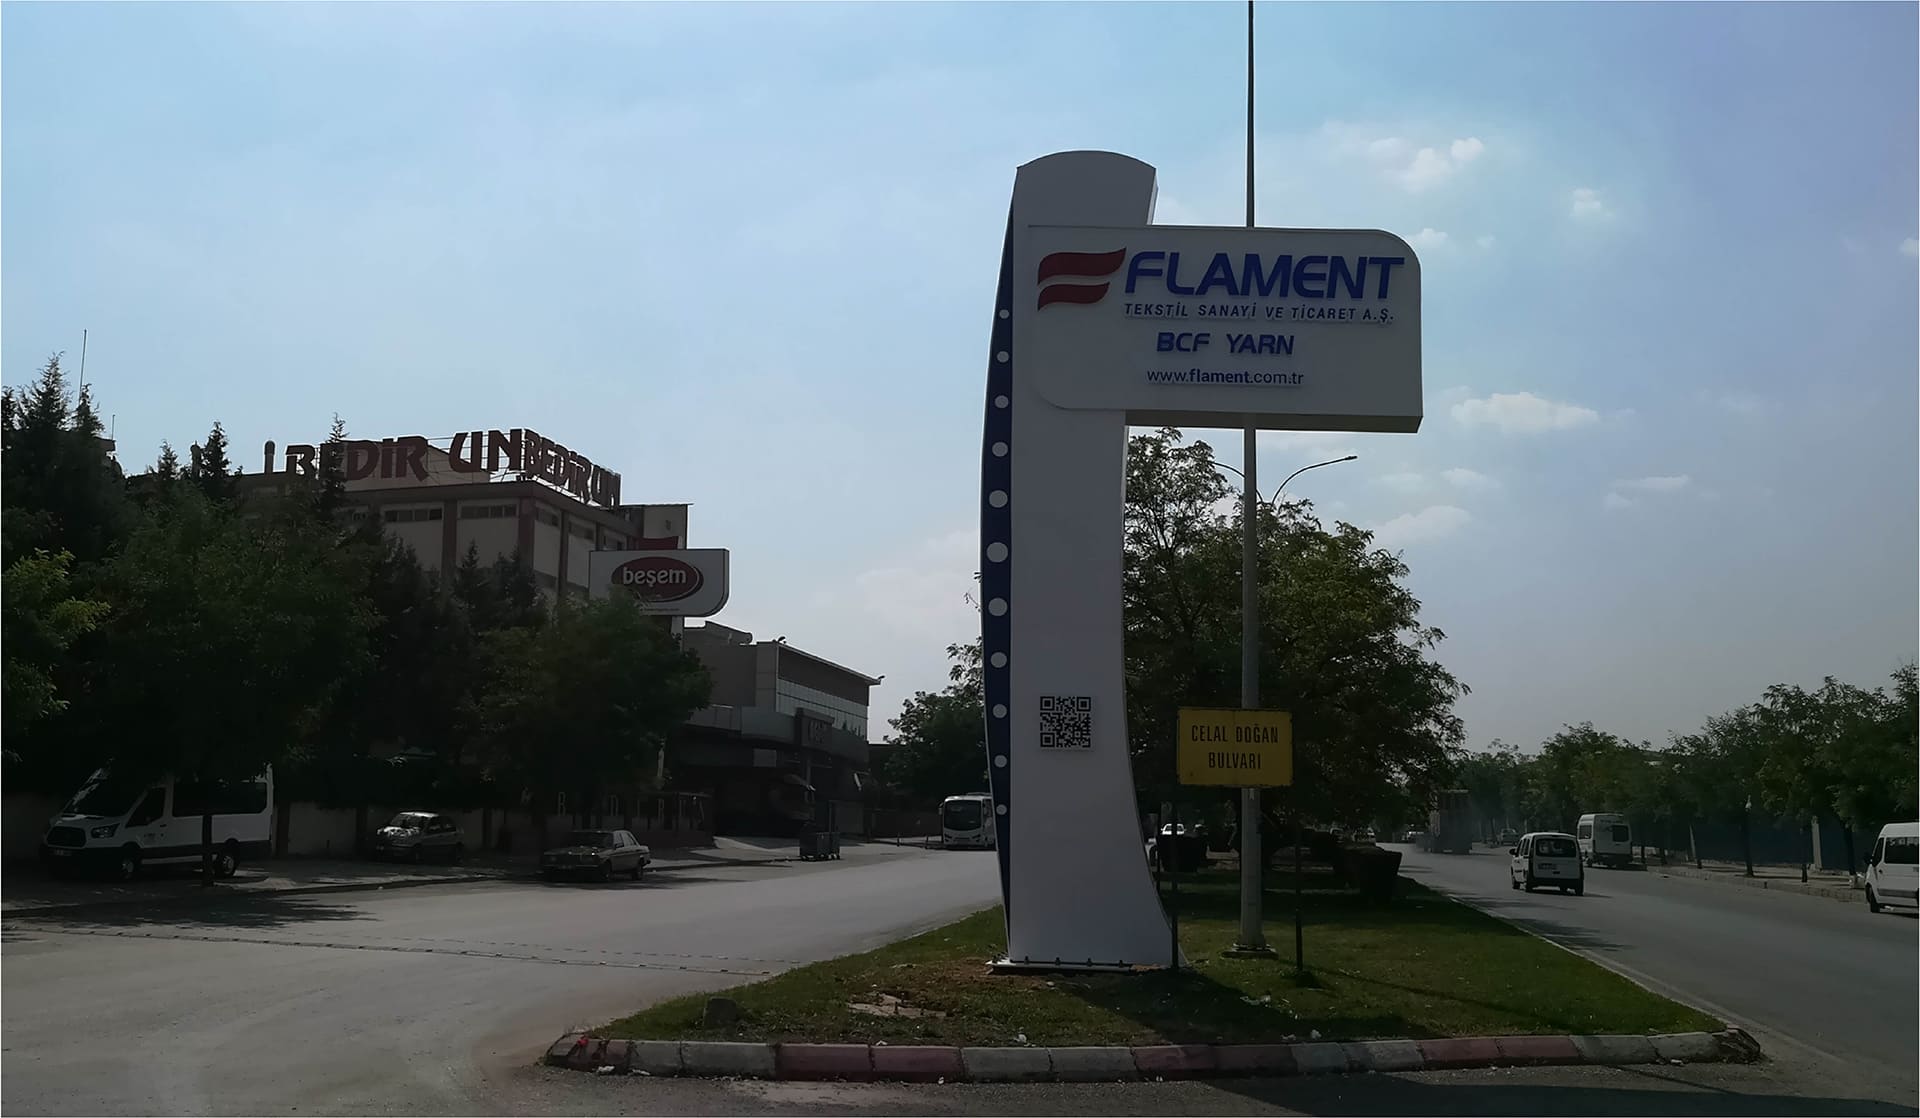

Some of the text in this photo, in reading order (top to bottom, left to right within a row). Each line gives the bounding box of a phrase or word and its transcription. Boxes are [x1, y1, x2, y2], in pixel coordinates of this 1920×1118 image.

[1124, 251, 1405, 299] FLAMENT
[1124, 302, 1395, 325] TEKSTİL SANAYİ VE TİCARET A.Ş.
[1156, 331, 1295, 355] BCF YARN
[1147, 367, 1304, 386] www.flament.com.tr
[448, 428, 522, 474] UN
[622, 566, 687, 588] beşem
[1191, 722, 1279, 744] CELAL DOĞAN
[1208, 752, 1262, 770] BULVARI
